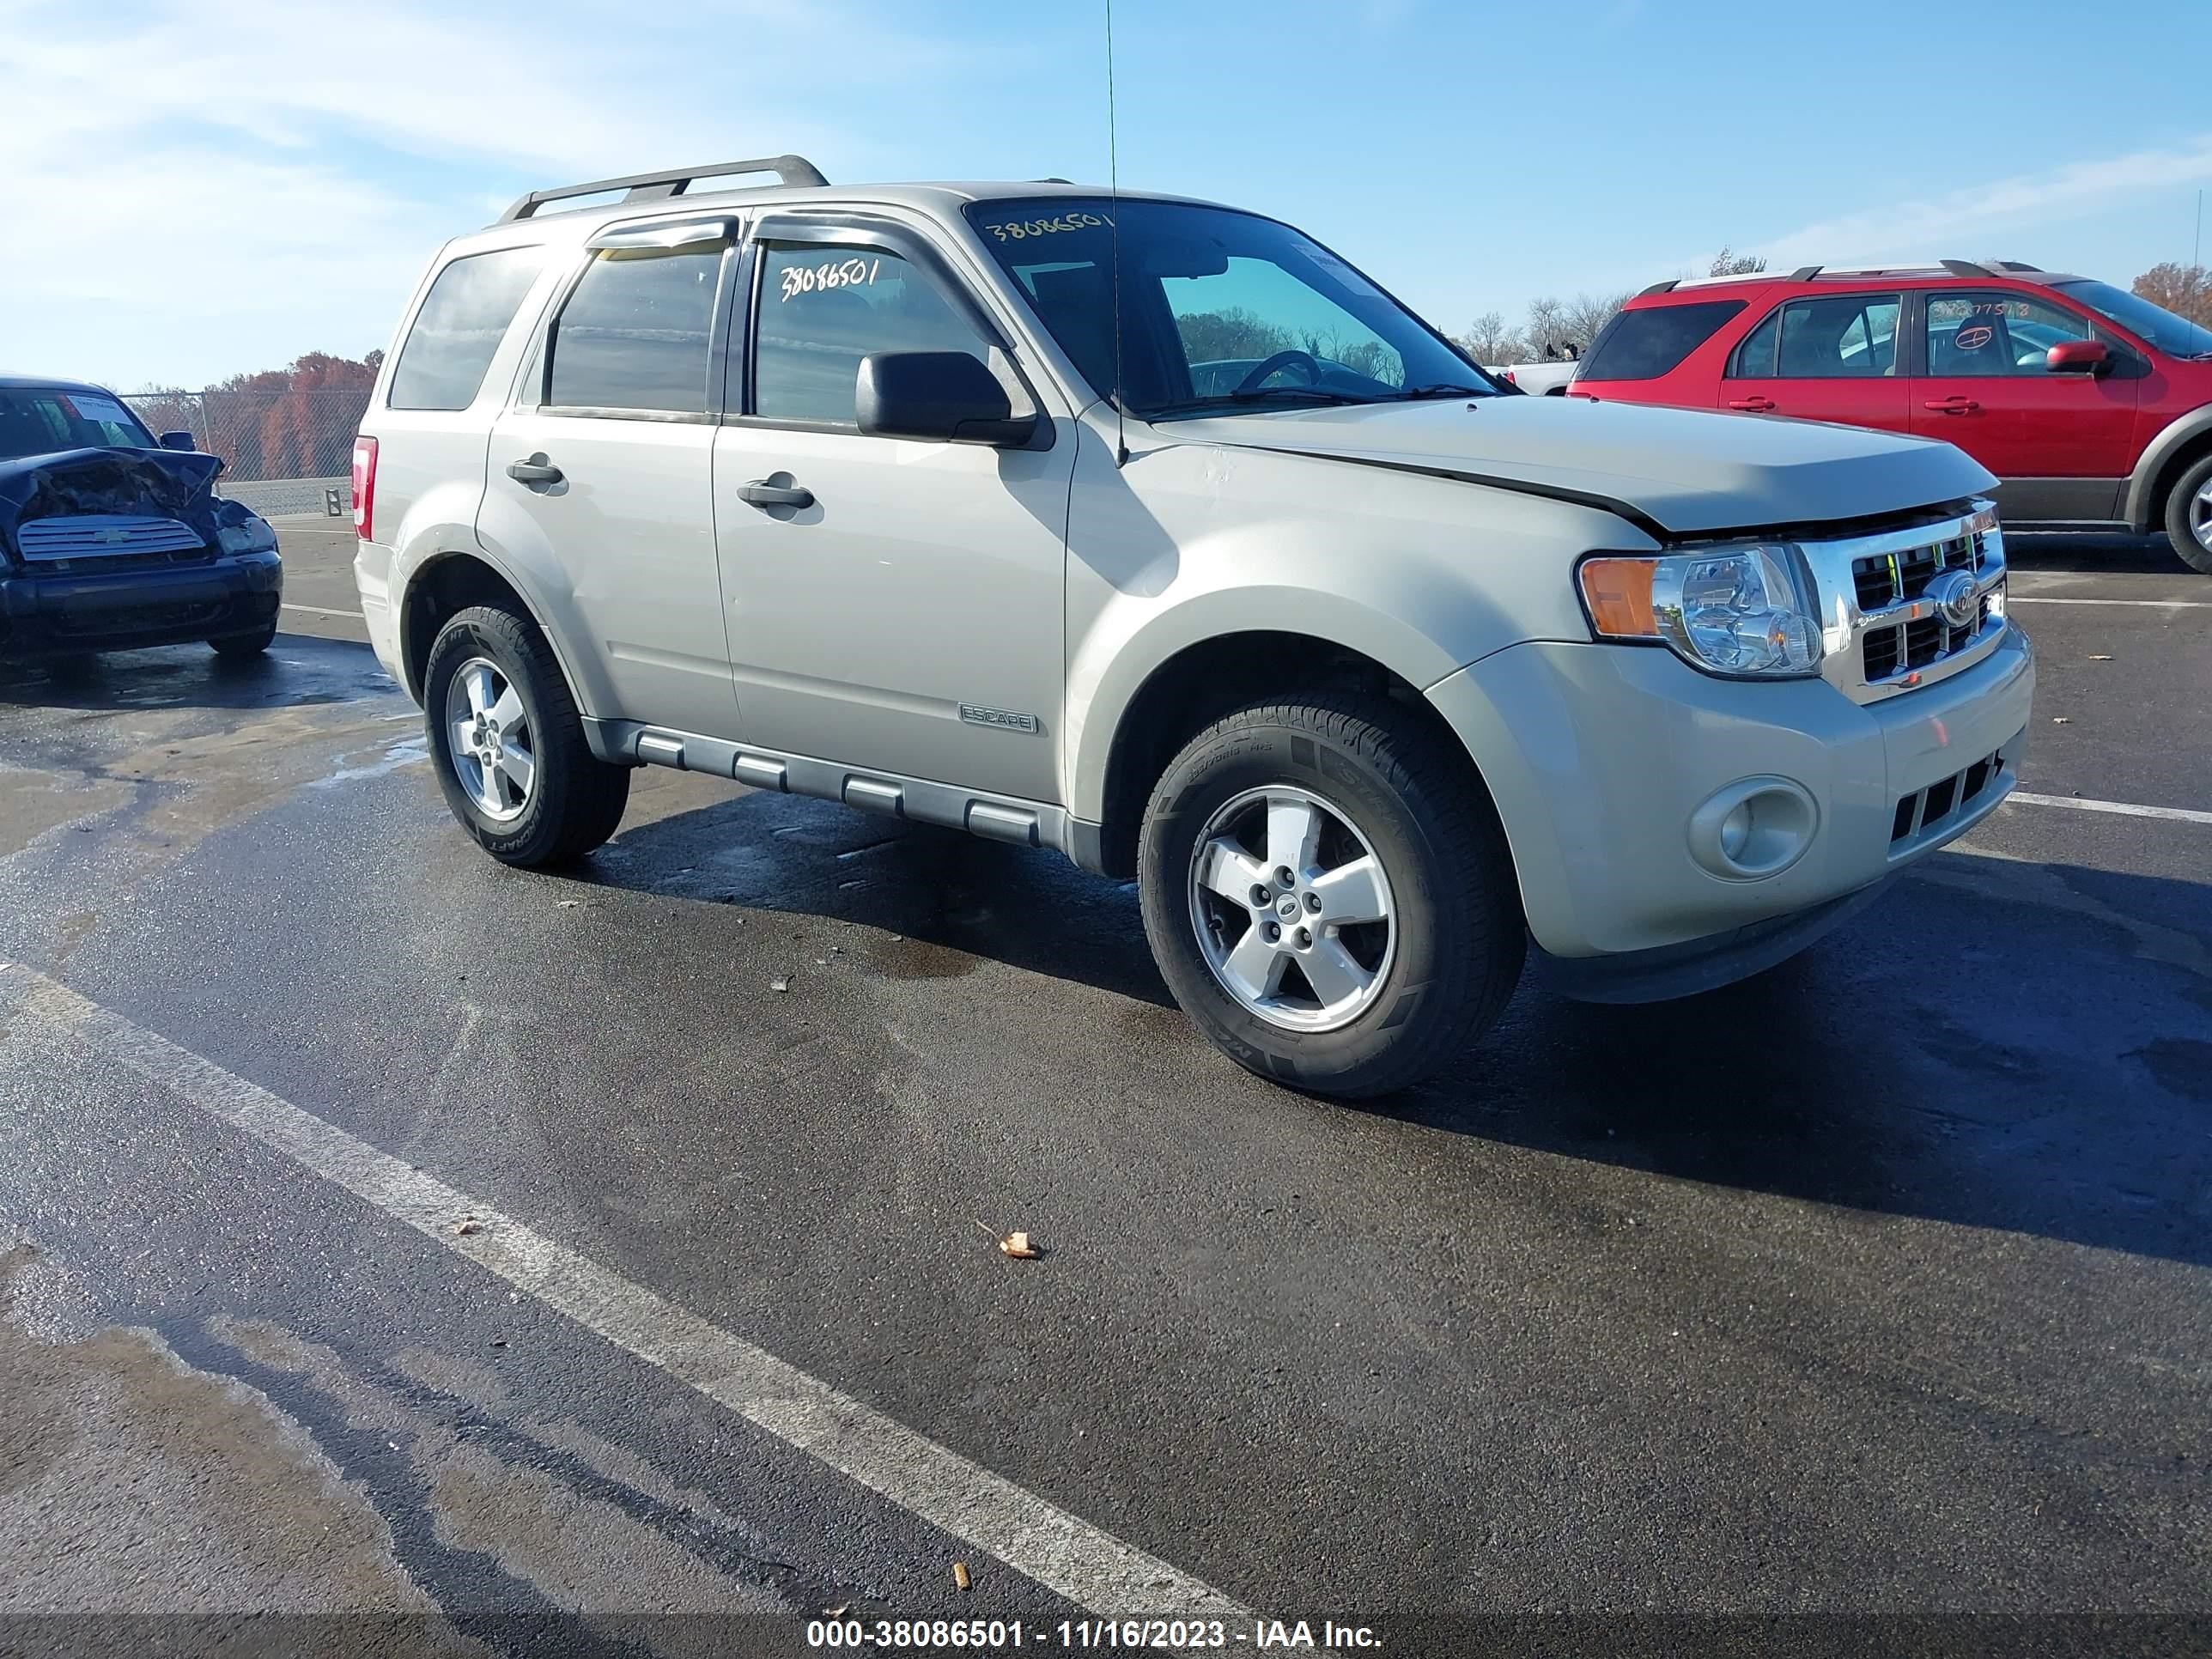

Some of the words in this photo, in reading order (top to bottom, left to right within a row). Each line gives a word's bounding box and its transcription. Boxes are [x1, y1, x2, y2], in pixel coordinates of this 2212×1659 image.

[986, 214, 1115, 241] 38086501
[780, 258, 879, 302] 38086501
[962, 706, 1031, 729] ESCAPE
